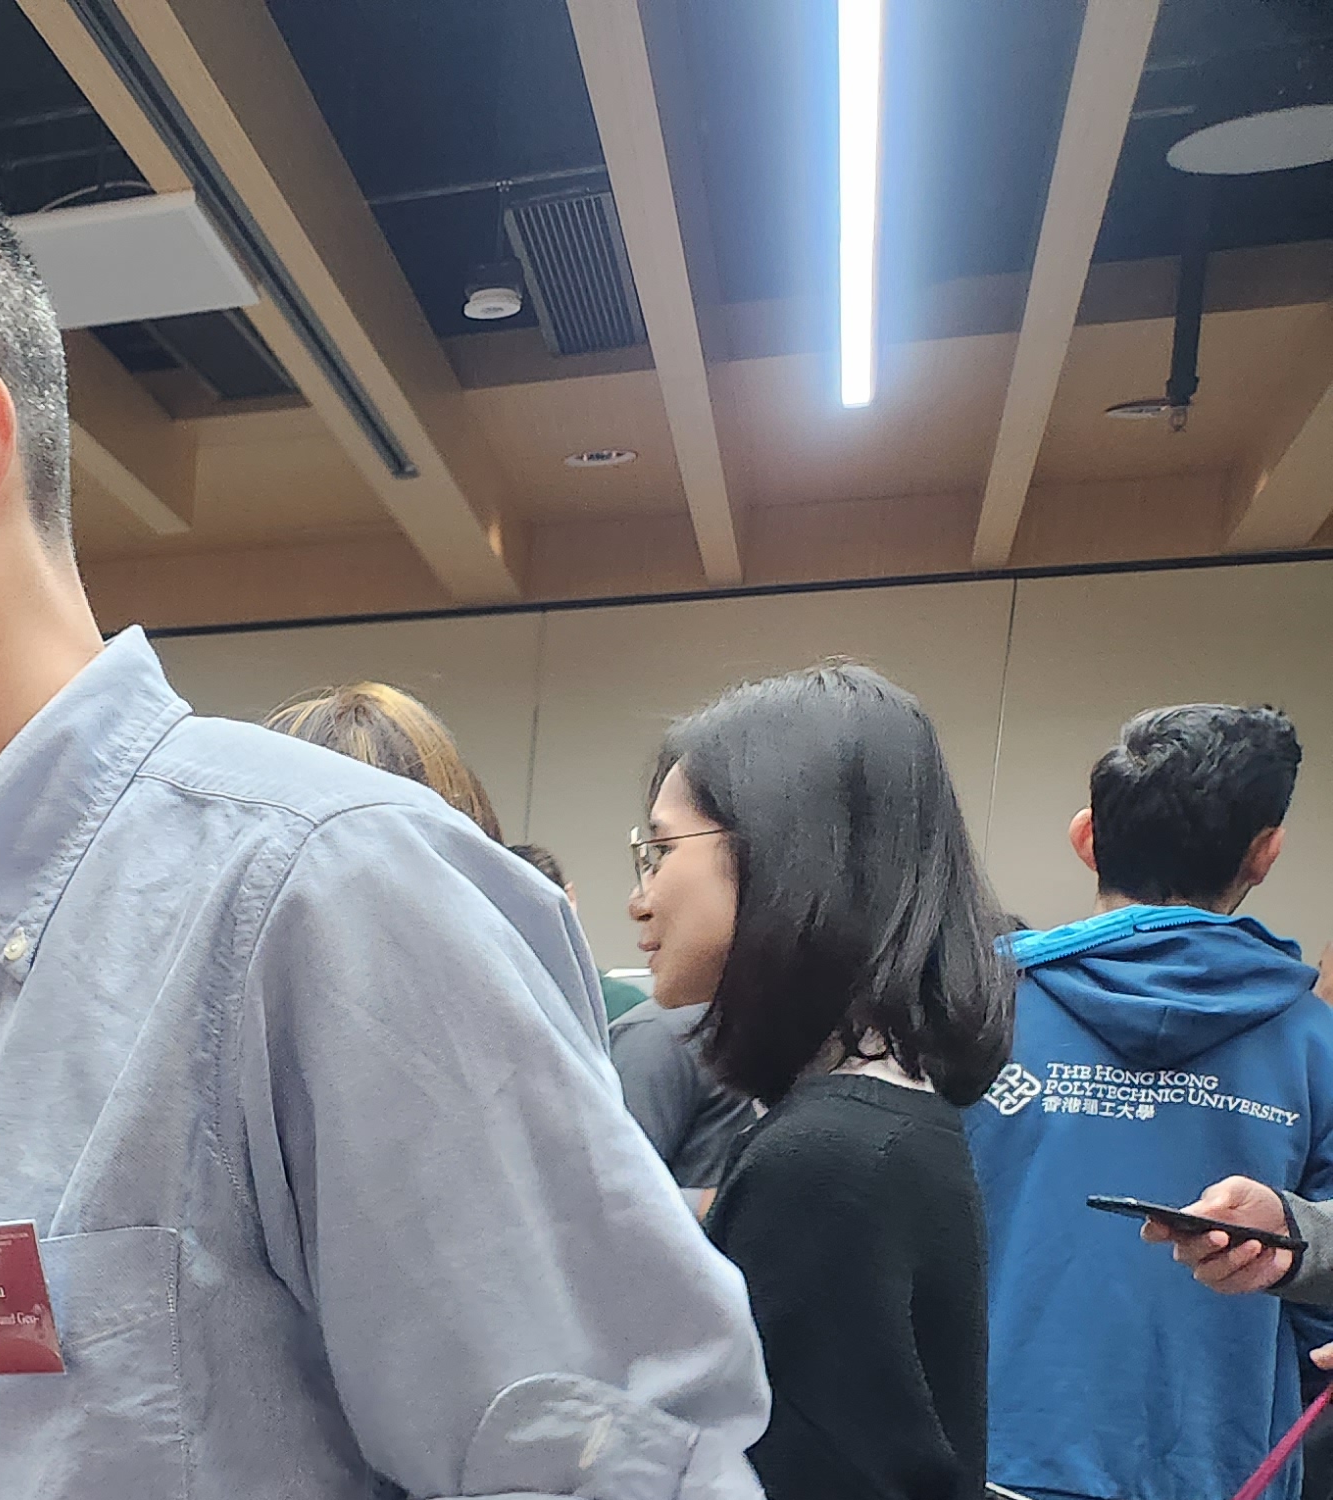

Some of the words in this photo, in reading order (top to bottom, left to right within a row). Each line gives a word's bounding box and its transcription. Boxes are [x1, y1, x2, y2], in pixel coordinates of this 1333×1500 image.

[1047, 1063, 1091, 1080] THE
[1095, 1065, 1155, 1086] HONG
[1158, 1070, 1219, 1090] KONG
[1042, 1096, 1156, 1120] 香港理工大學
[1044, 1080, 1185, 1103] POLYTECHNIC
[1188, 1088, 1299, 1127] UNIVERSITY
[0, 1313, 15, 1325] and
